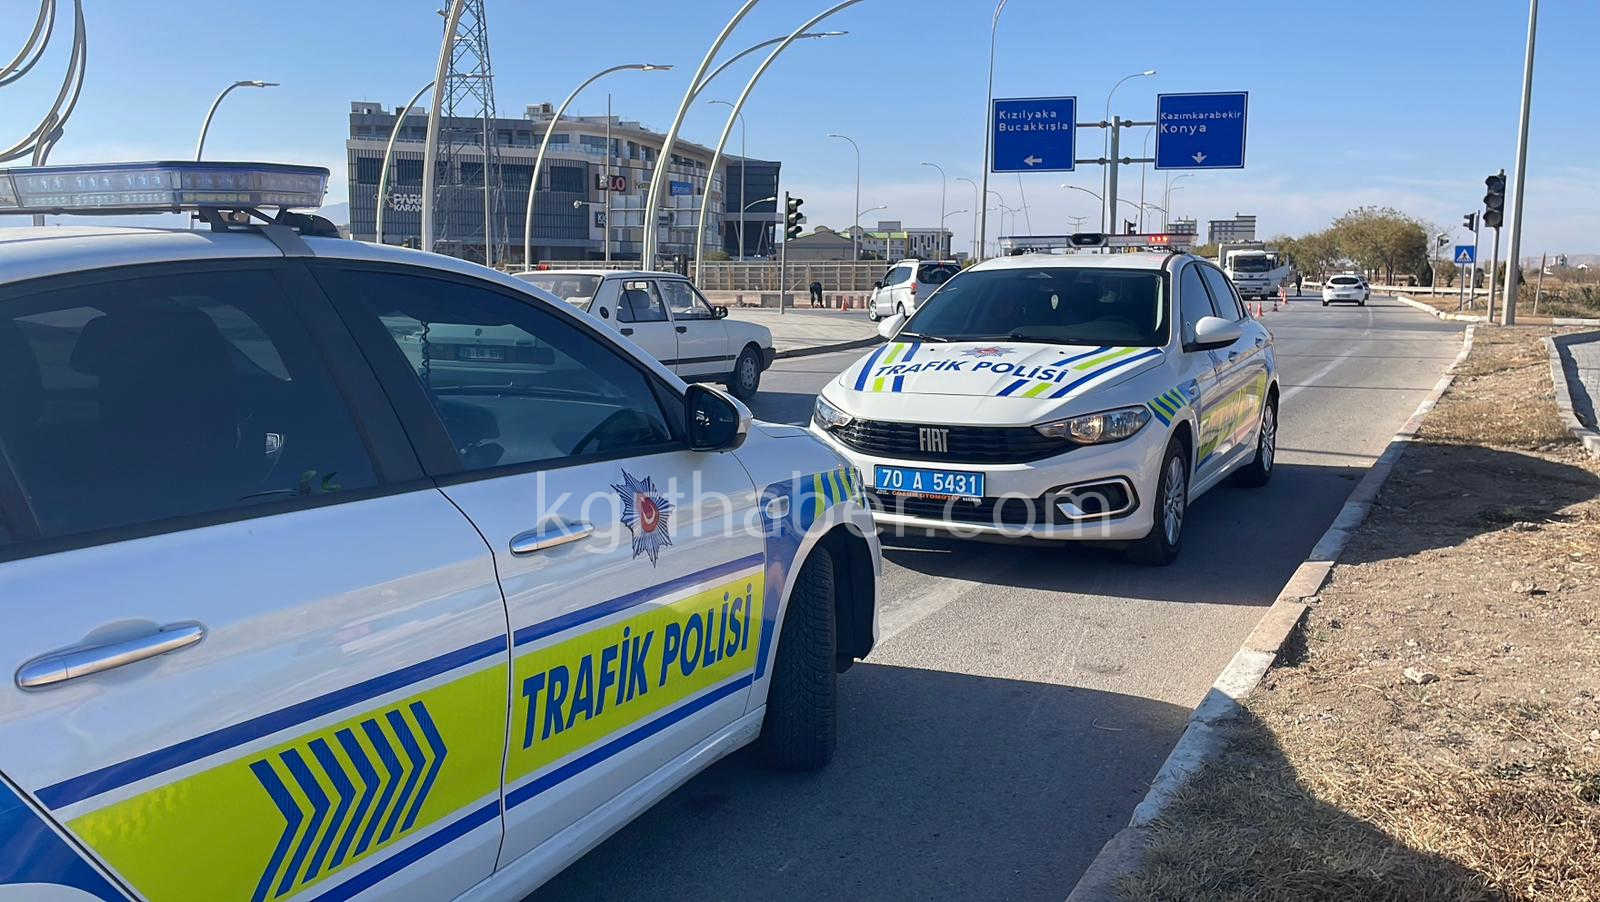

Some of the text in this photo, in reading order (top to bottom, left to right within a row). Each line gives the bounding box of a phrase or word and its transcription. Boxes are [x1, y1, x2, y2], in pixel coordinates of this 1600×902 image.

[999, 109, 1057, 120] Kızılyaka
[999, 121, 1068, 132] Bucakkışla
[1160, 123, 1207, 135] Konya
[875, 359, 1070, 382] TRAFİK POLİSİ
[919, 427, 950, 453] FIAT
[882, 469, 977, 494] 70 A 5431
[522, 583, 752, 750] TRAFİK POLİSİ
